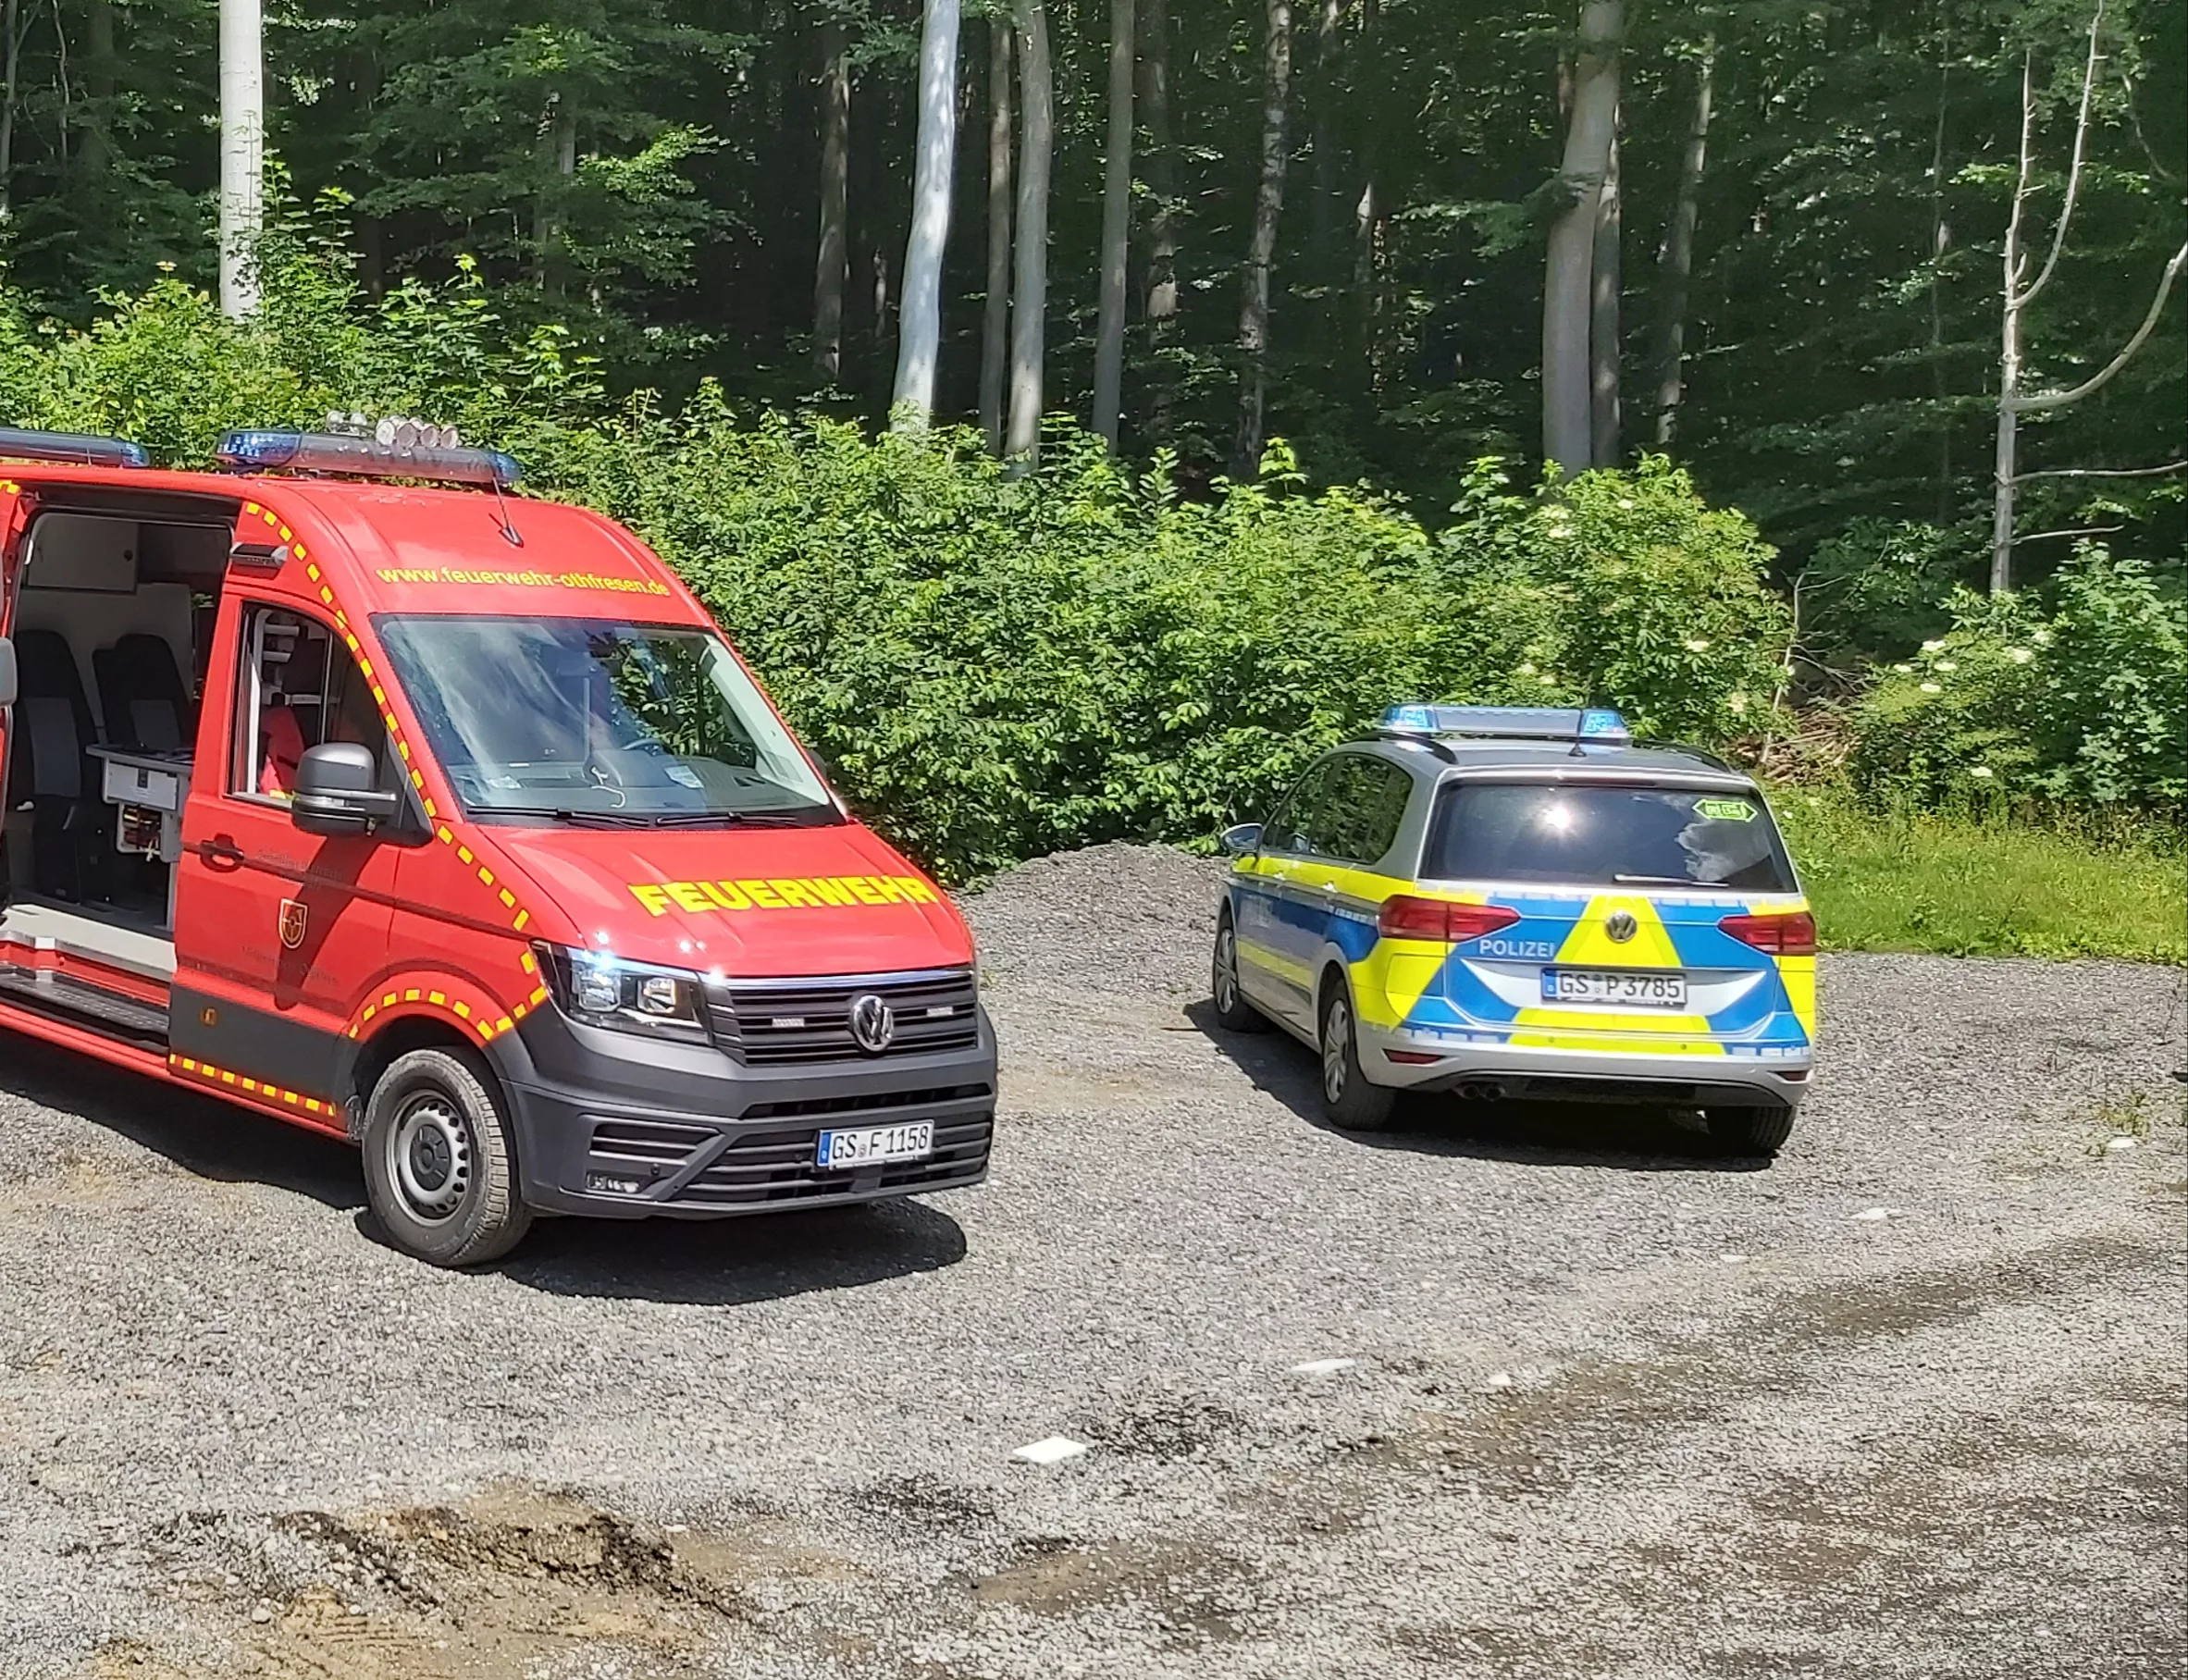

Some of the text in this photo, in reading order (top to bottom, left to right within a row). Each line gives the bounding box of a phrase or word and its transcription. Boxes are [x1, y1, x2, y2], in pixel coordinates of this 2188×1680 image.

[376, 567, 671, 597] www.feuerwehr-othfresen.de
[627, 874, 939, 917] FEUERWEHR
[1479, 939, 1555, 957] POLIZEI
[1560, 973, 1681, 999] GS P 3785
[833, 1125, 929, 1159] GS F 1158
